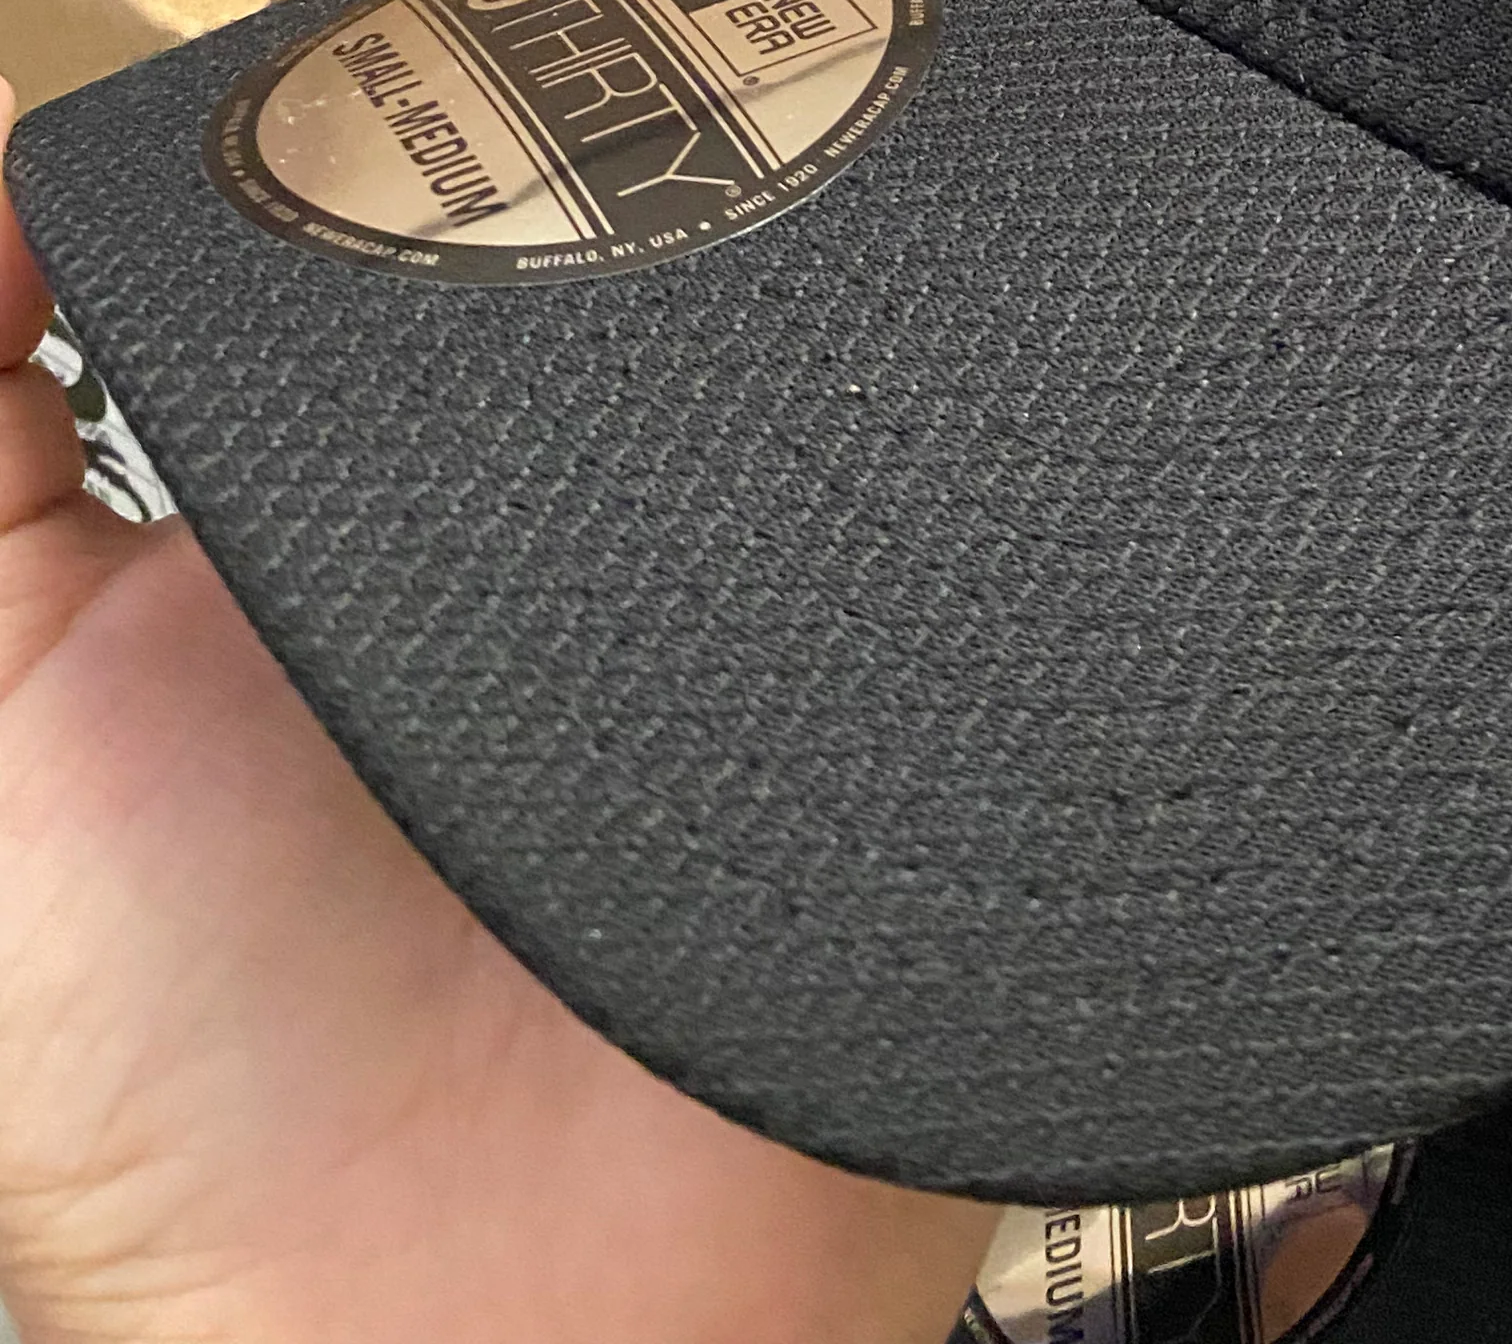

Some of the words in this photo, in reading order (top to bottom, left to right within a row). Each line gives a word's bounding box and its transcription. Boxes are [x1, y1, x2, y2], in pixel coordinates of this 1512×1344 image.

[725, 1, 796, 55] ERA
[332, 32, 510, 227] SMALL-MEDIUM
[649, 227, 688, 248] USA
[725, 190, 777, 221] SINCE
[777, 163, 819, 192] 1920
